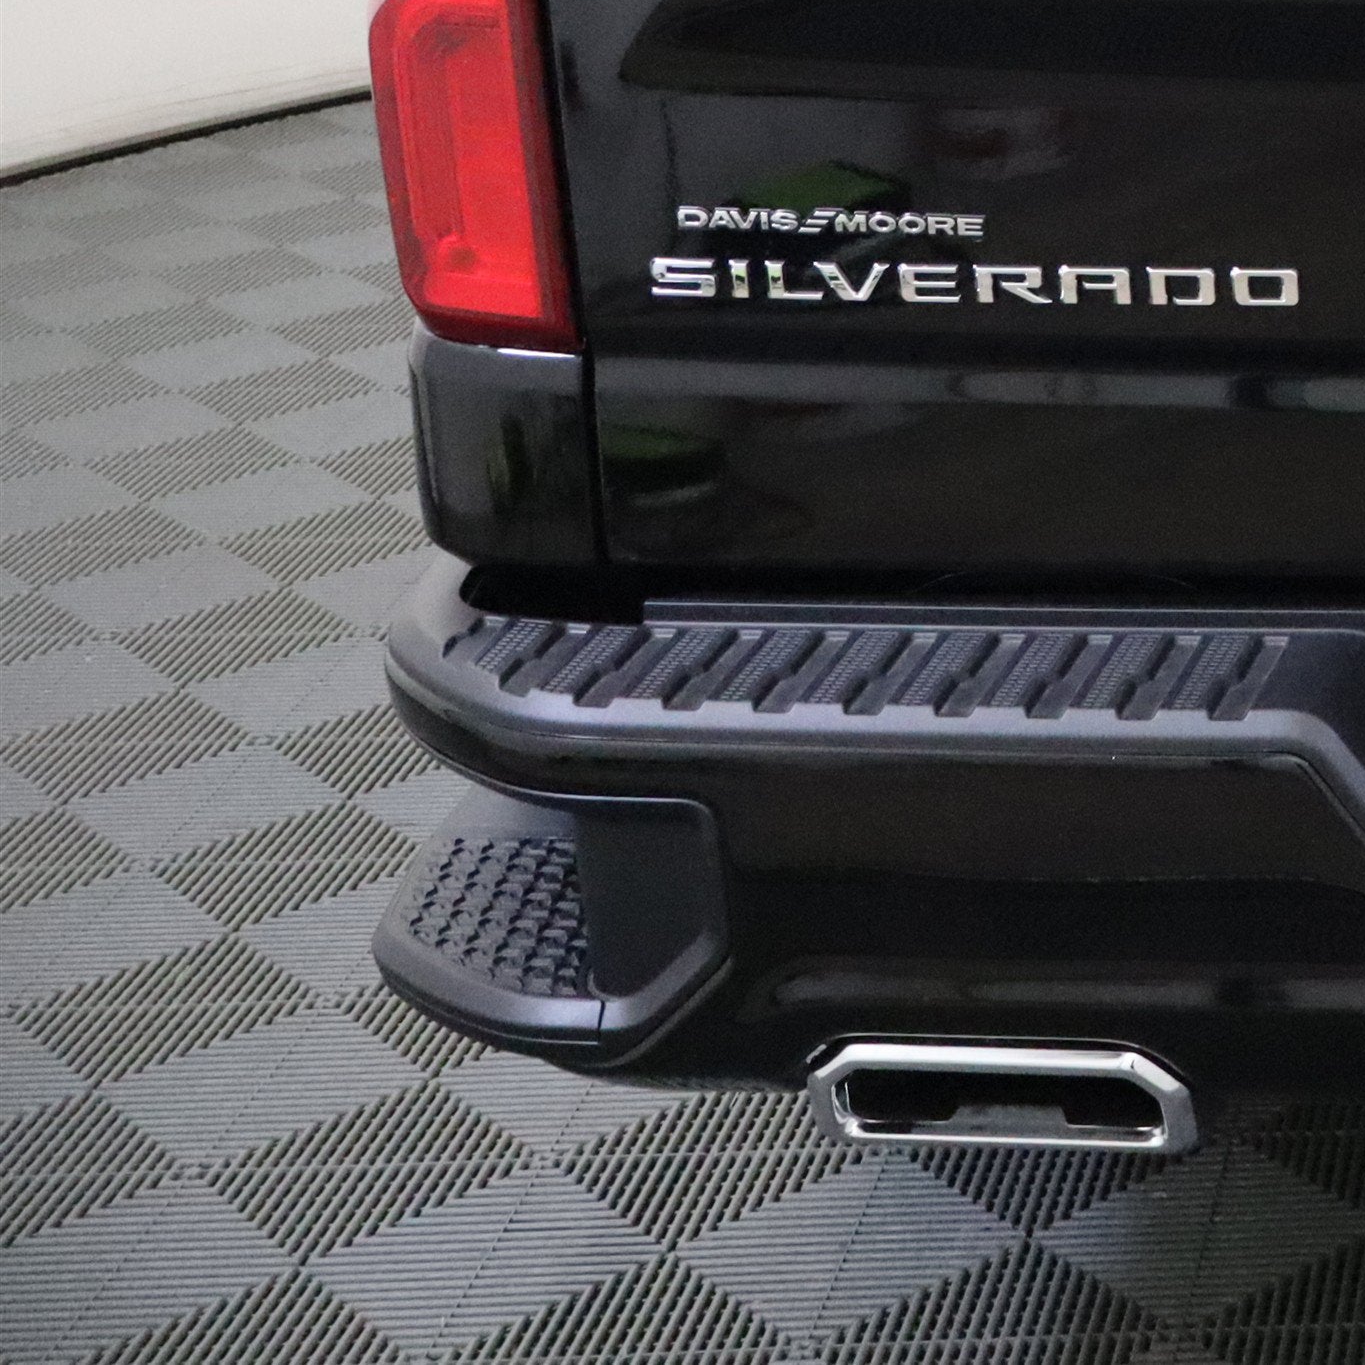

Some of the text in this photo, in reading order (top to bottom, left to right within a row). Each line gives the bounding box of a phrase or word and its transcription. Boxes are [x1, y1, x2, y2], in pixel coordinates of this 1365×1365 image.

[676, 205, 985, 237] DAVIS MOORE
[649, 256, 1301, 306] SILVERADO
